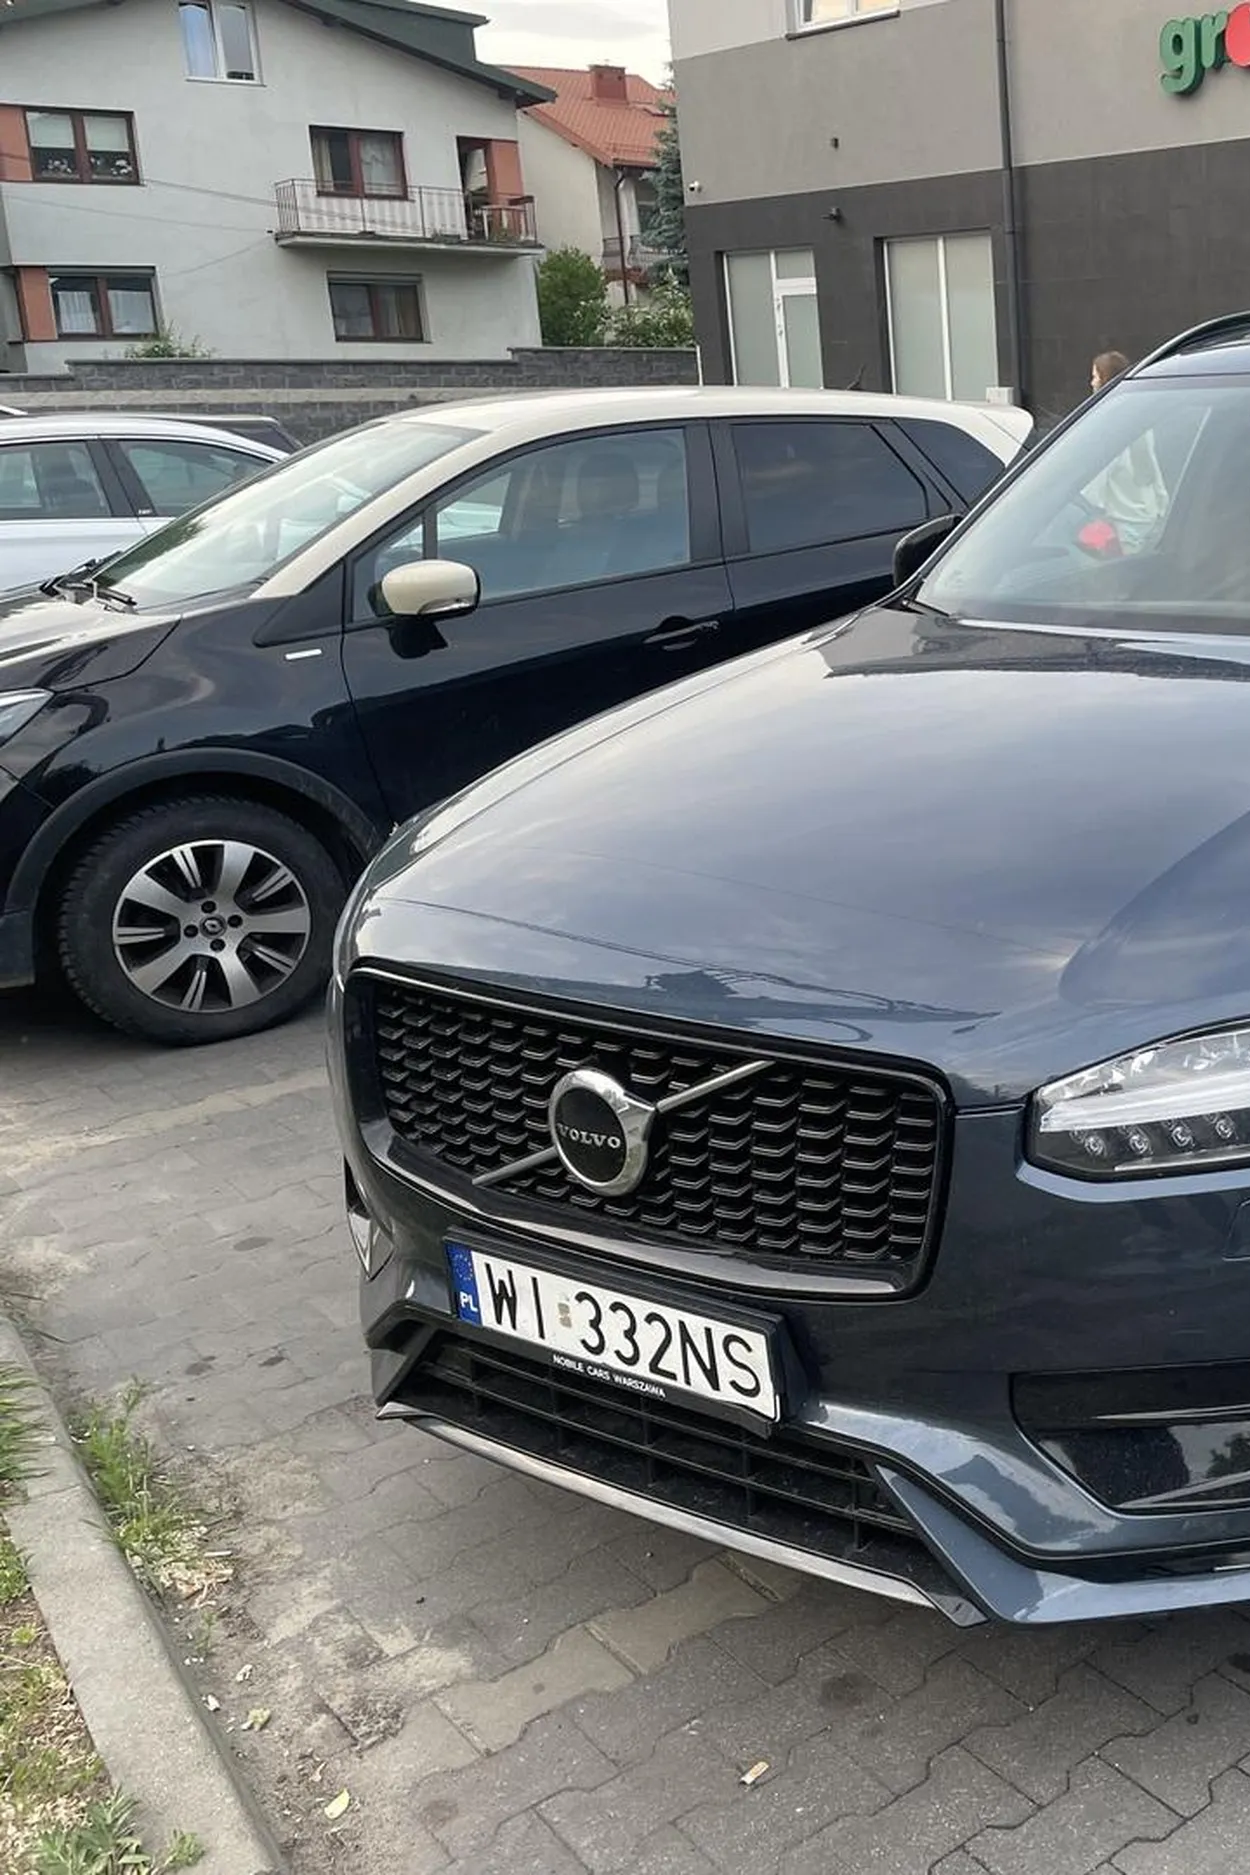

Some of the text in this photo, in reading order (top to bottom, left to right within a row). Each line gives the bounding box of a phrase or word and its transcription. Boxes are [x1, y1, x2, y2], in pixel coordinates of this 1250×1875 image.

[556, 1122, 621, 1149] VOLVO
[460, 1291, 479, 1313] PL
[485, 1262, 761, 1398] WI 332NS
[587, 1365, 610, 1381] CARS
[613, 1373, 666, 1399] WARSZAWA
